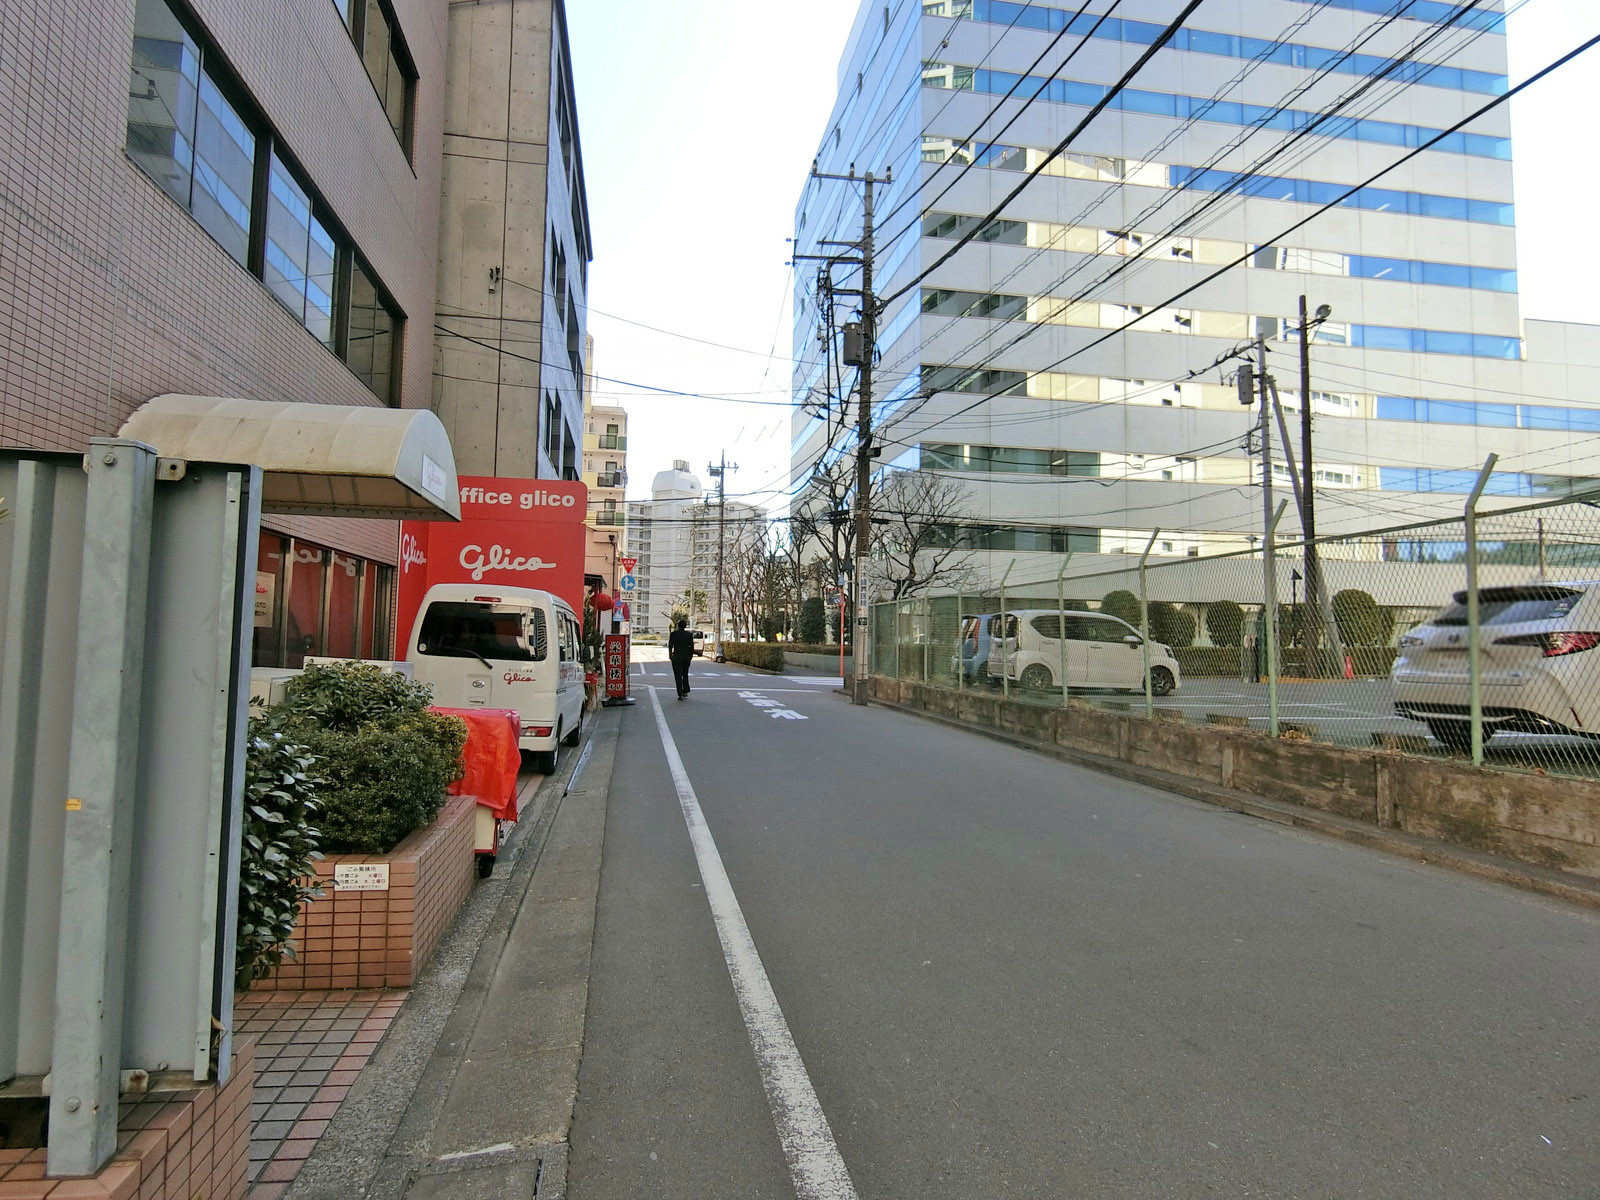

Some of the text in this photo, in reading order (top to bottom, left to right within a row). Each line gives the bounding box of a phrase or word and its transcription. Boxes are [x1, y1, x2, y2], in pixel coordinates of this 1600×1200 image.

[460, 487, 575, 510] ffice glico
[402, 533, 427, 573] Glico
[459, 544, 557, 581] Glico
[503, 672, 537, 685] Glico
